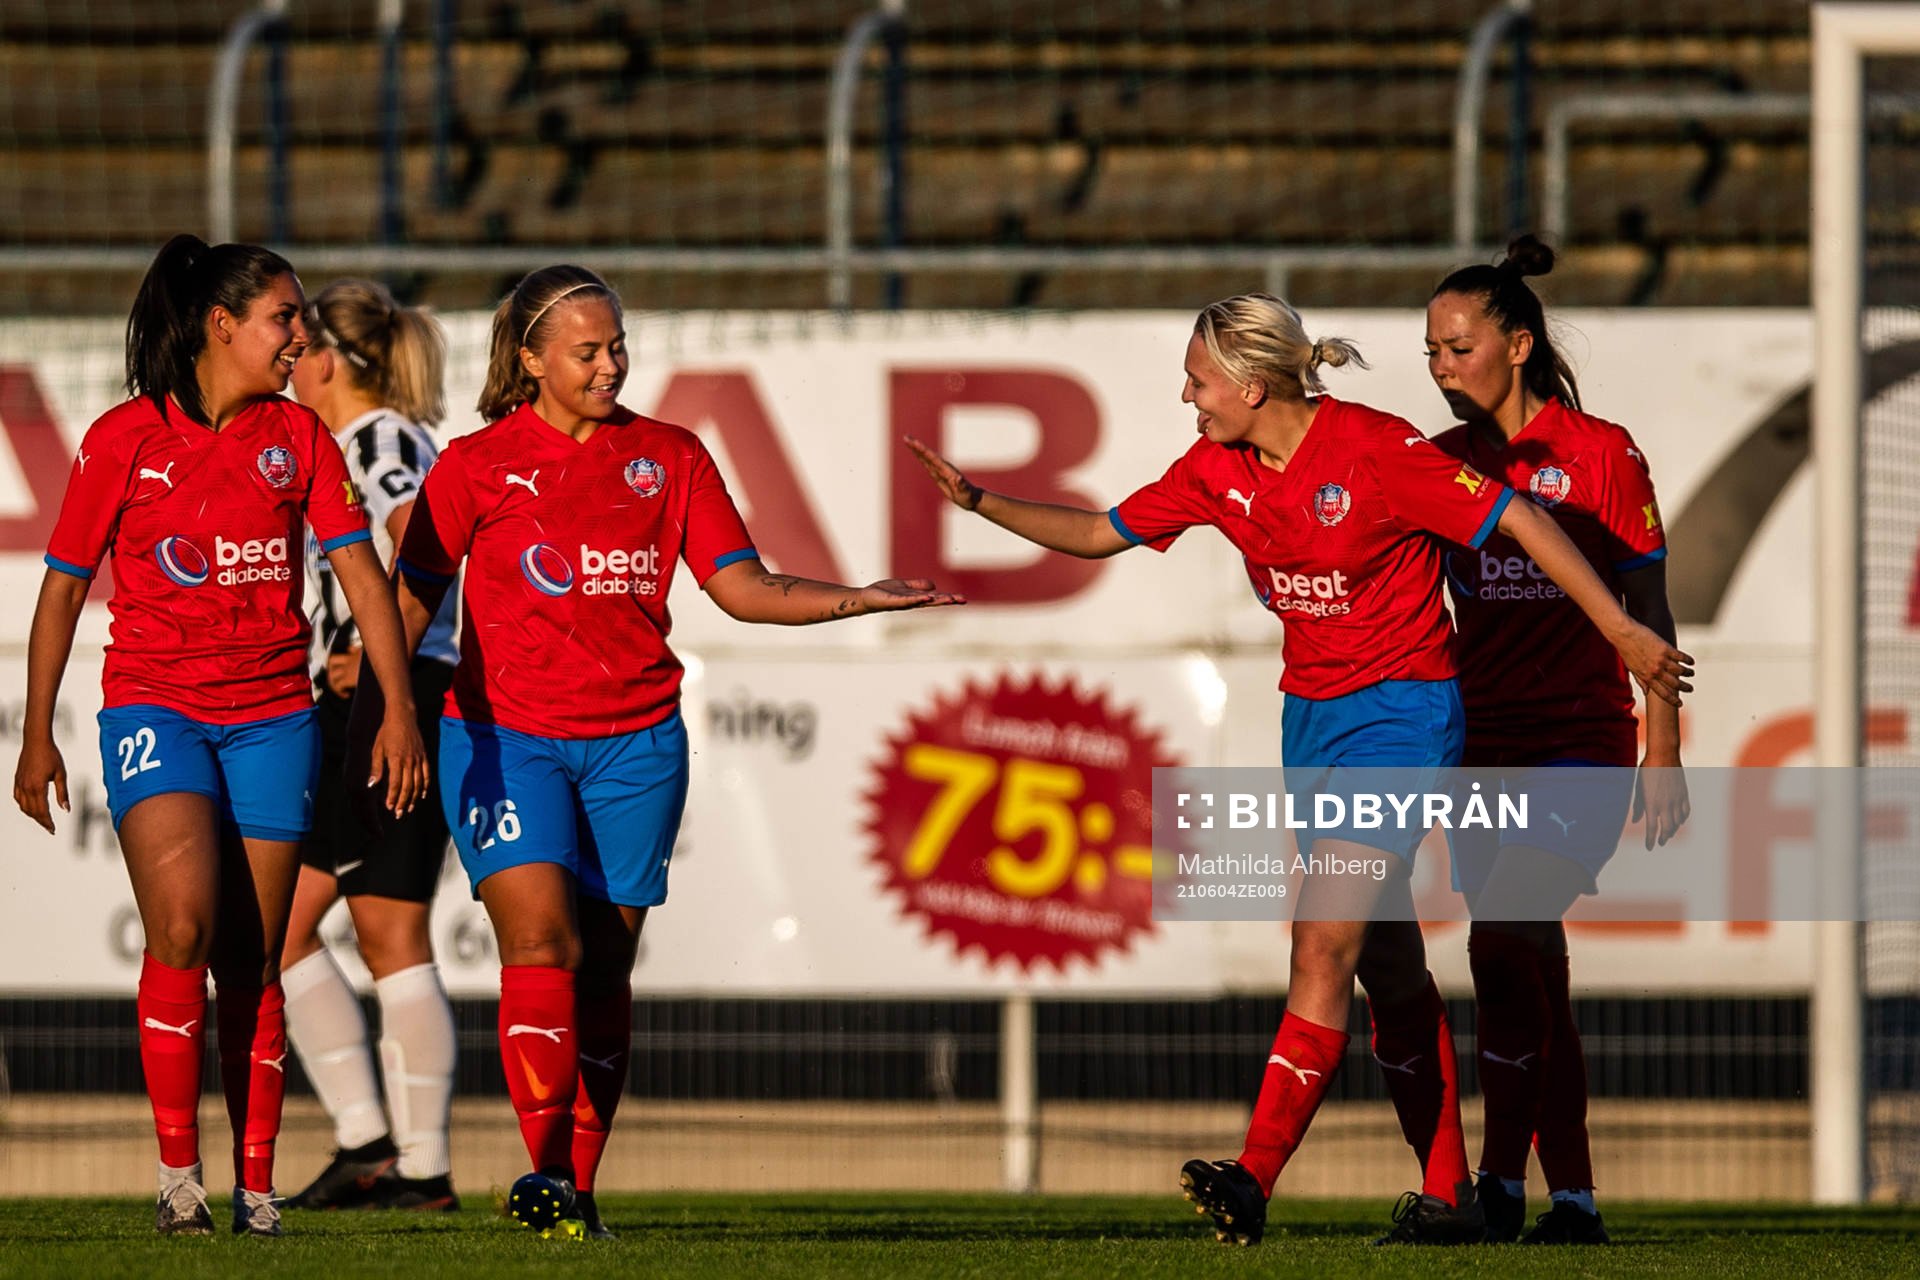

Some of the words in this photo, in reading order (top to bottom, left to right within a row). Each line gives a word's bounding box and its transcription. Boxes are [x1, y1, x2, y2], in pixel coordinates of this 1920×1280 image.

[215, 535, 288, 567] bea
[580, 543, 660, 576] beat
[217, 565, 291, 586] diabete
[582, 576, 657, 596] diabetes
[1268, 566, 1350, 600] beat
[1276, 596, 1351, 617] diabetes
[118, 727, 162, 782] 22
[469, 799, 521, 850] 26
[903, 743, 1179, 898] 75:-
